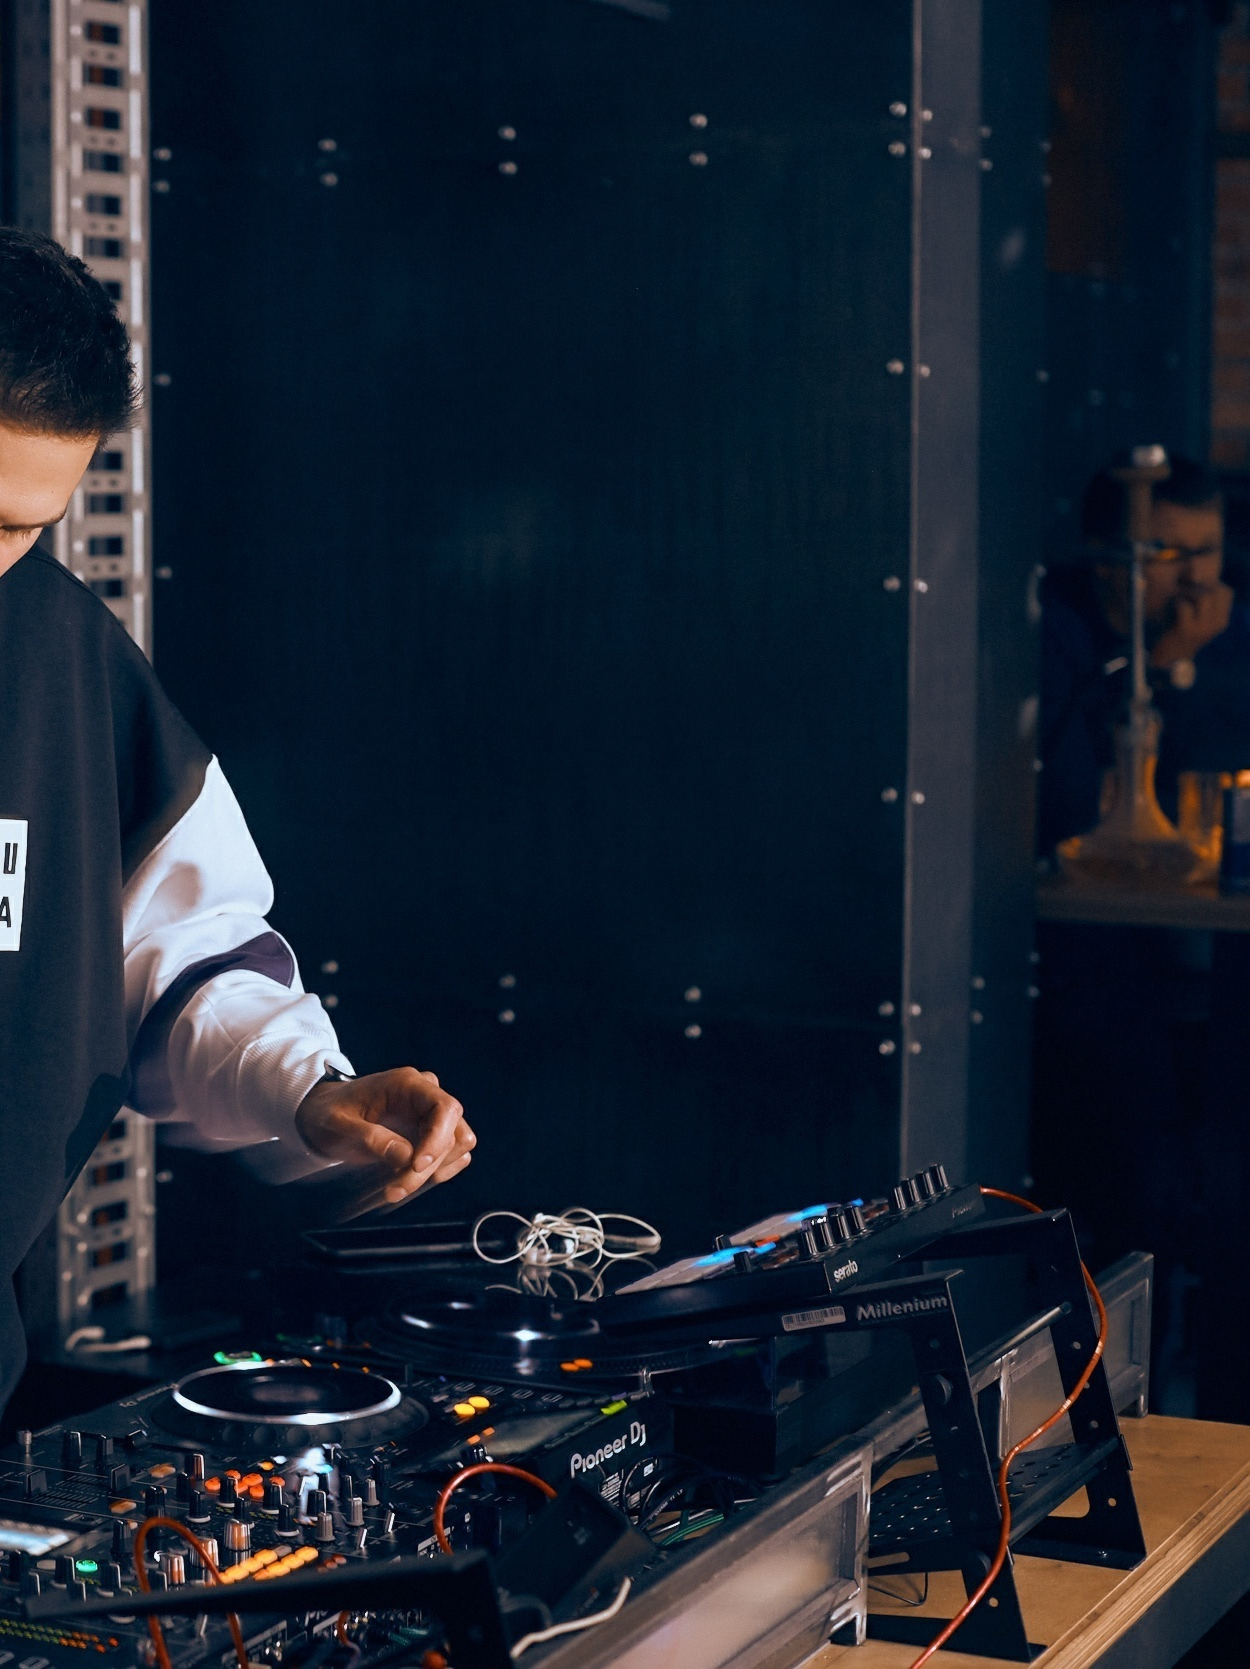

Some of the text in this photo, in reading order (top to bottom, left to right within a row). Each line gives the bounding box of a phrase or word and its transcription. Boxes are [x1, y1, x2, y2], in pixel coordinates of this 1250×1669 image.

[833, 1259, 859, 1283] serato
[856, 1295, 948, 1322] Millenium
[570, 1434, 628, 1479] Pioneer
